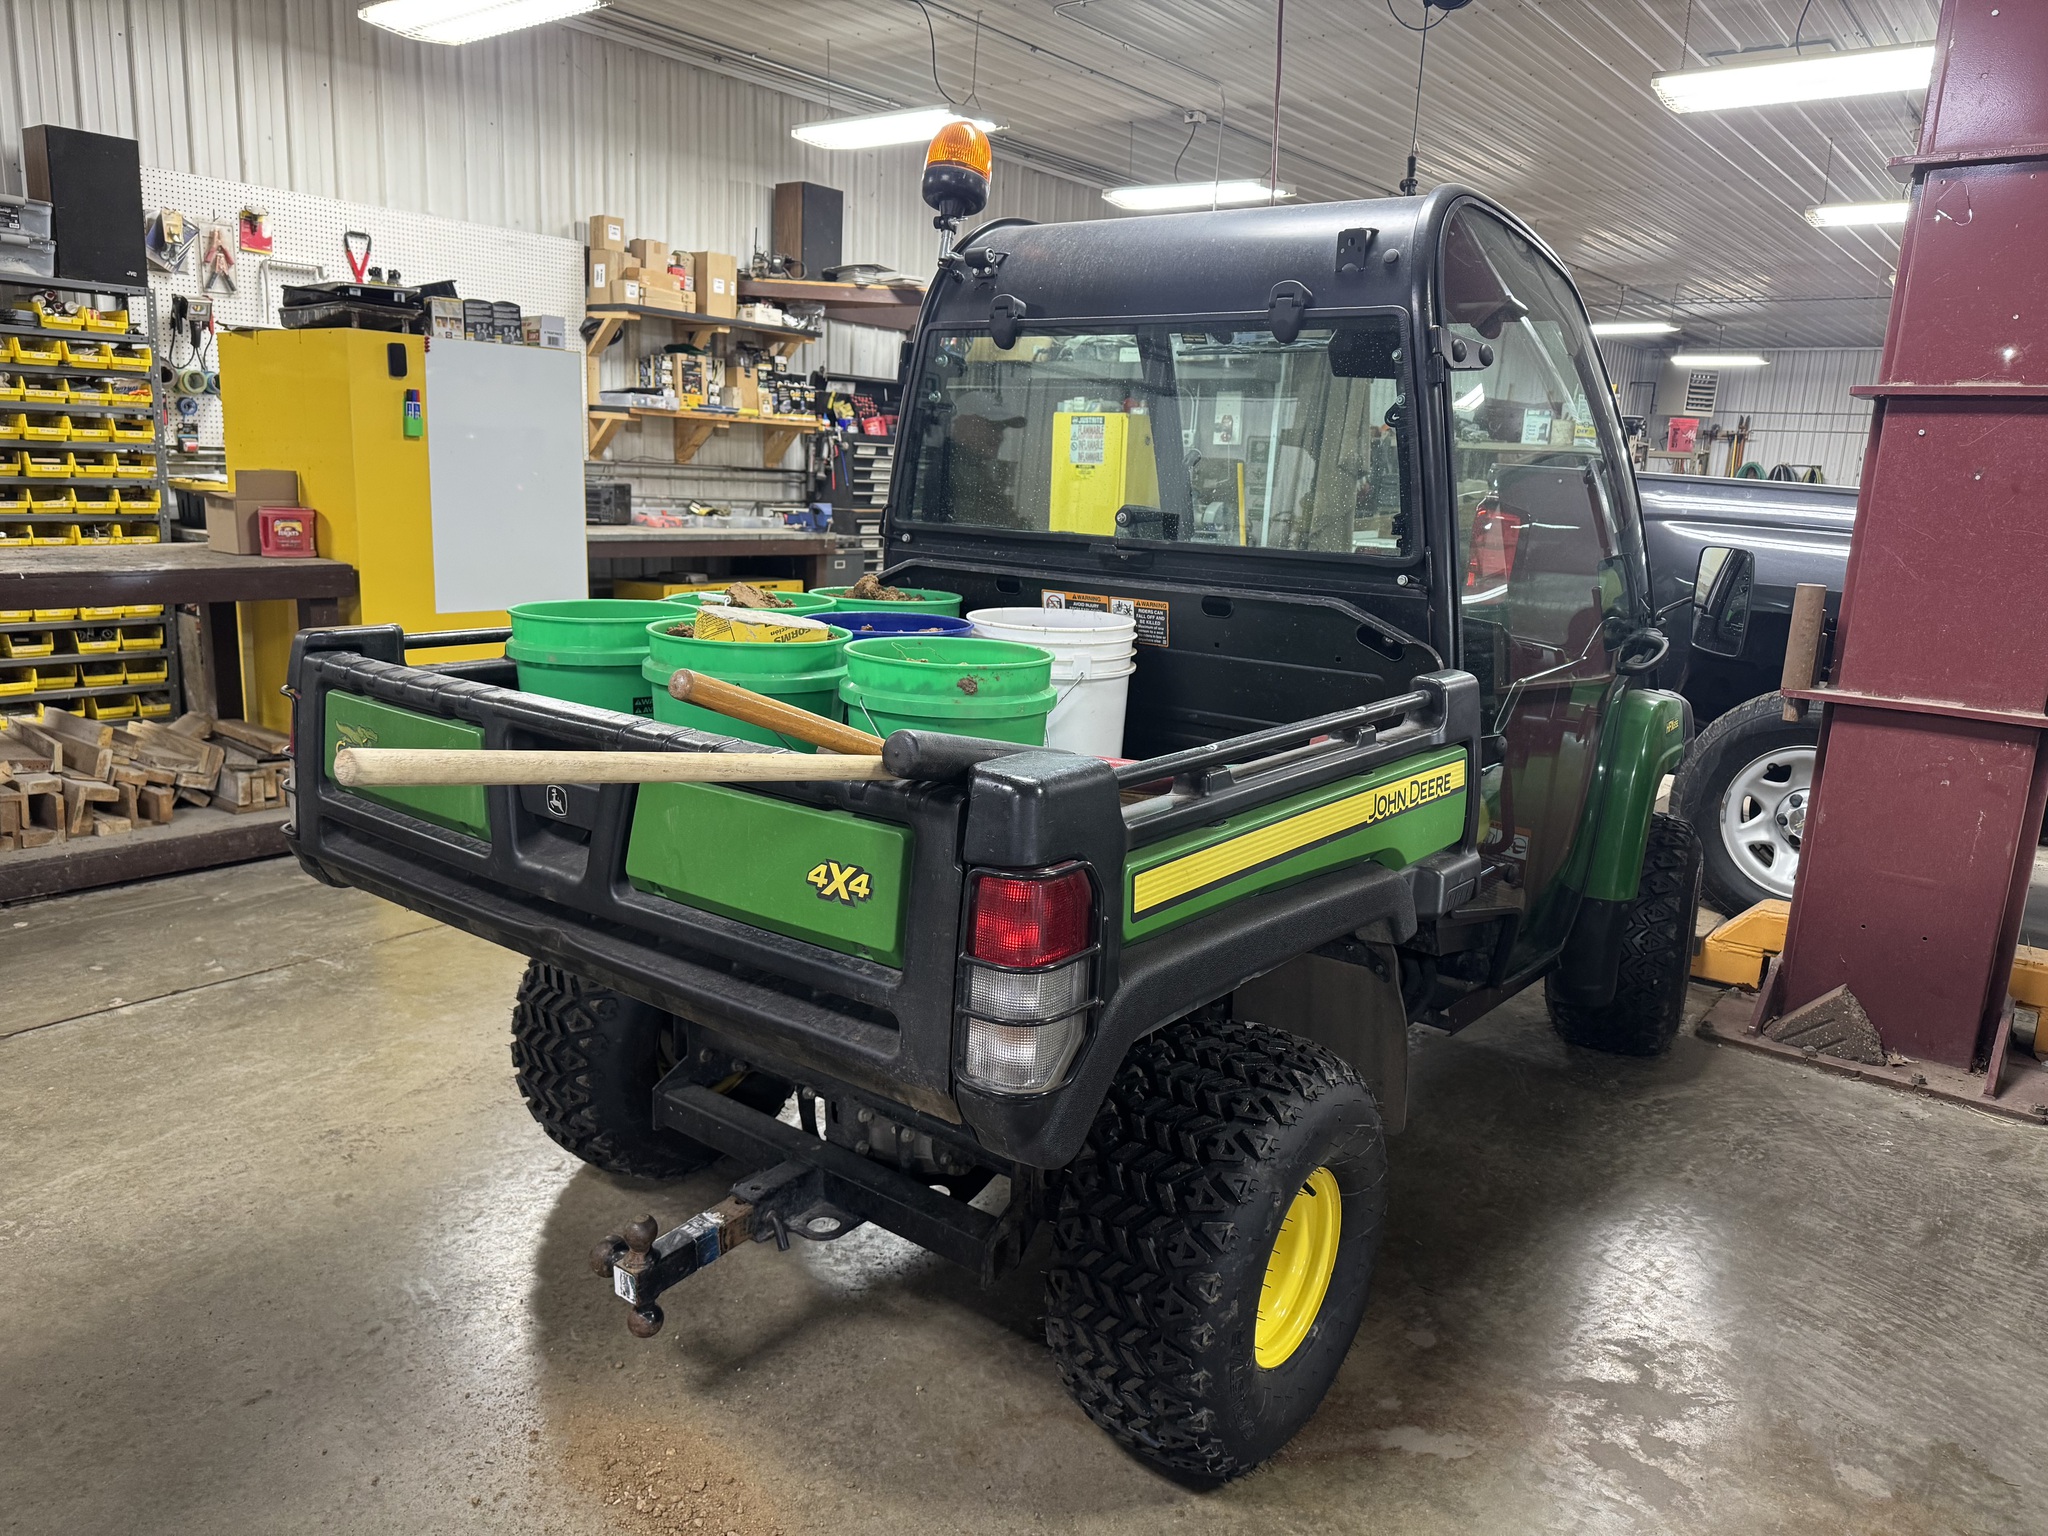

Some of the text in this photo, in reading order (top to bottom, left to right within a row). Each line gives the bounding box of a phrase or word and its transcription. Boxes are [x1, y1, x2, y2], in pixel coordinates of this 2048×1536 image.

[278, 528, 299, 537] Folgers
[1141, 601, 1167, 609] WARNING
[1368, 772, 1452, 821] JOHN DEERE
[807, 861, 870, 900] 4X4
